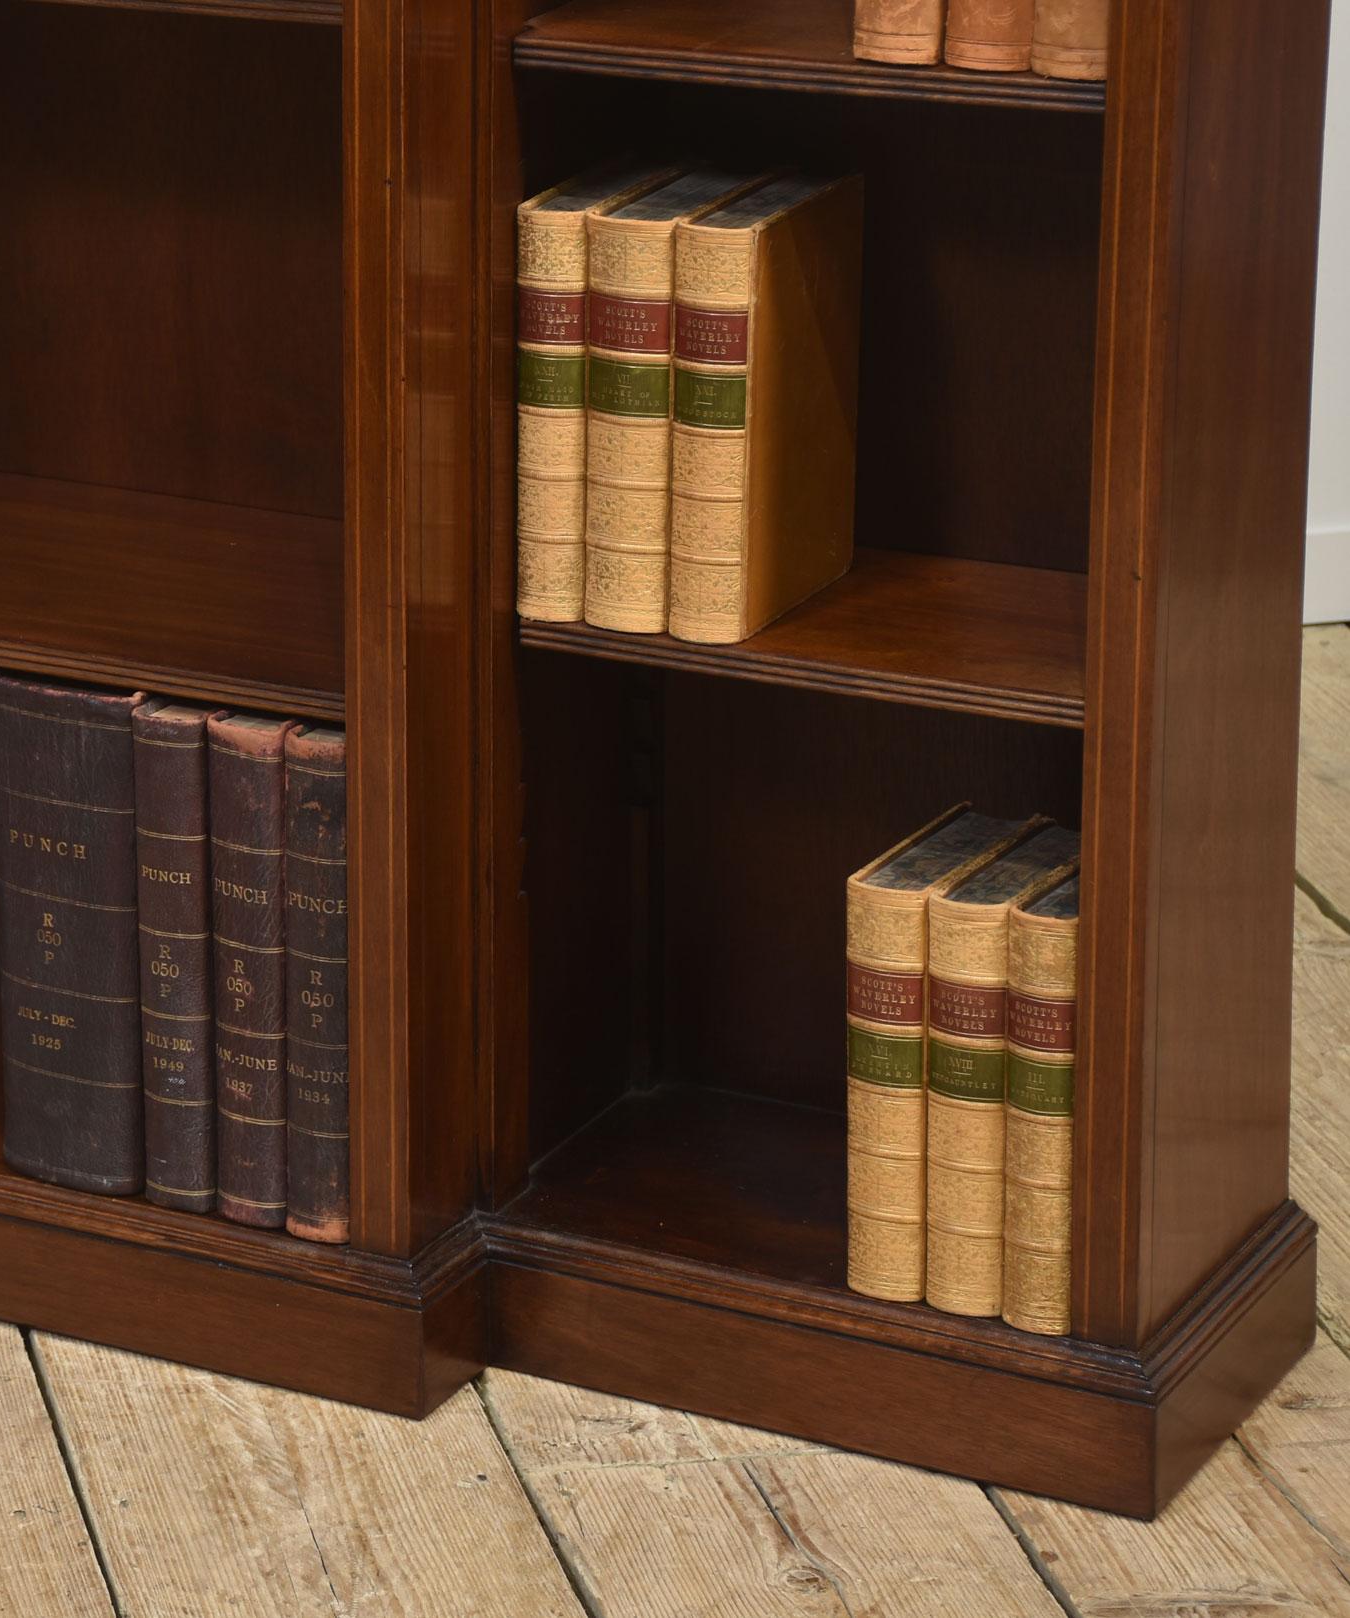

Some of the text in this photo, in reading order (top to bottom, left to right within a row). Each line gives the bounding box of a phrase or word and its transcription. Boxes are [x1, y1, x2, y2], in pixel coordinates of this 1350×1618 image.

[685, 317, 730, 331] SCOTT'S
[679, 328, 742, 343] WAVERLEY
[685, 342, 728, 356] NOVELS
[9, 828, 87, 860] PUNCH
[140, 863, 193, 886] PUNCH
[213, 876, 269, 906] PUNCH
[287, 889, 348, 914] PUNCH
[42, 912, 55, 928] R
[36, 928, 62, 947] 050
[44, 949, 55, 965] P
[158, 944, 173, 960] R
[150, 960, 180, 978] 050
[233, 958, 246, 975] R
[226, 976, 253, 996] 050
[309, 969, 323, 986] R
[860, 975, 904, 993] SCOTT'S
[159, 982, 172, 998] P
[301, 990, 335, 1008] 050
[851, 984, 917, 1005] WAVERLEY
[940, 990, 986, 1006] SCOTT'S
[234, 997, 246, 1012] P
[860, 1001, 903, 1017] NOVELS
[932, 998, 998, 1019] WAVERLEY
[1015, 1000, 1059, 1019] SCOTT'S
[311, 1012, 323, 1029] P
[940, 1014, 985, 1031] NOVELS
[1009, 1010, 1072, 1031] WAVERLEY
[30, 1032, 62, 1052] 1925
[1014, 1026, 1057, 1044] NOVELS
[152, 1056, 185, 1073] 1949
[225, 1076, 254, 1095] 1937
